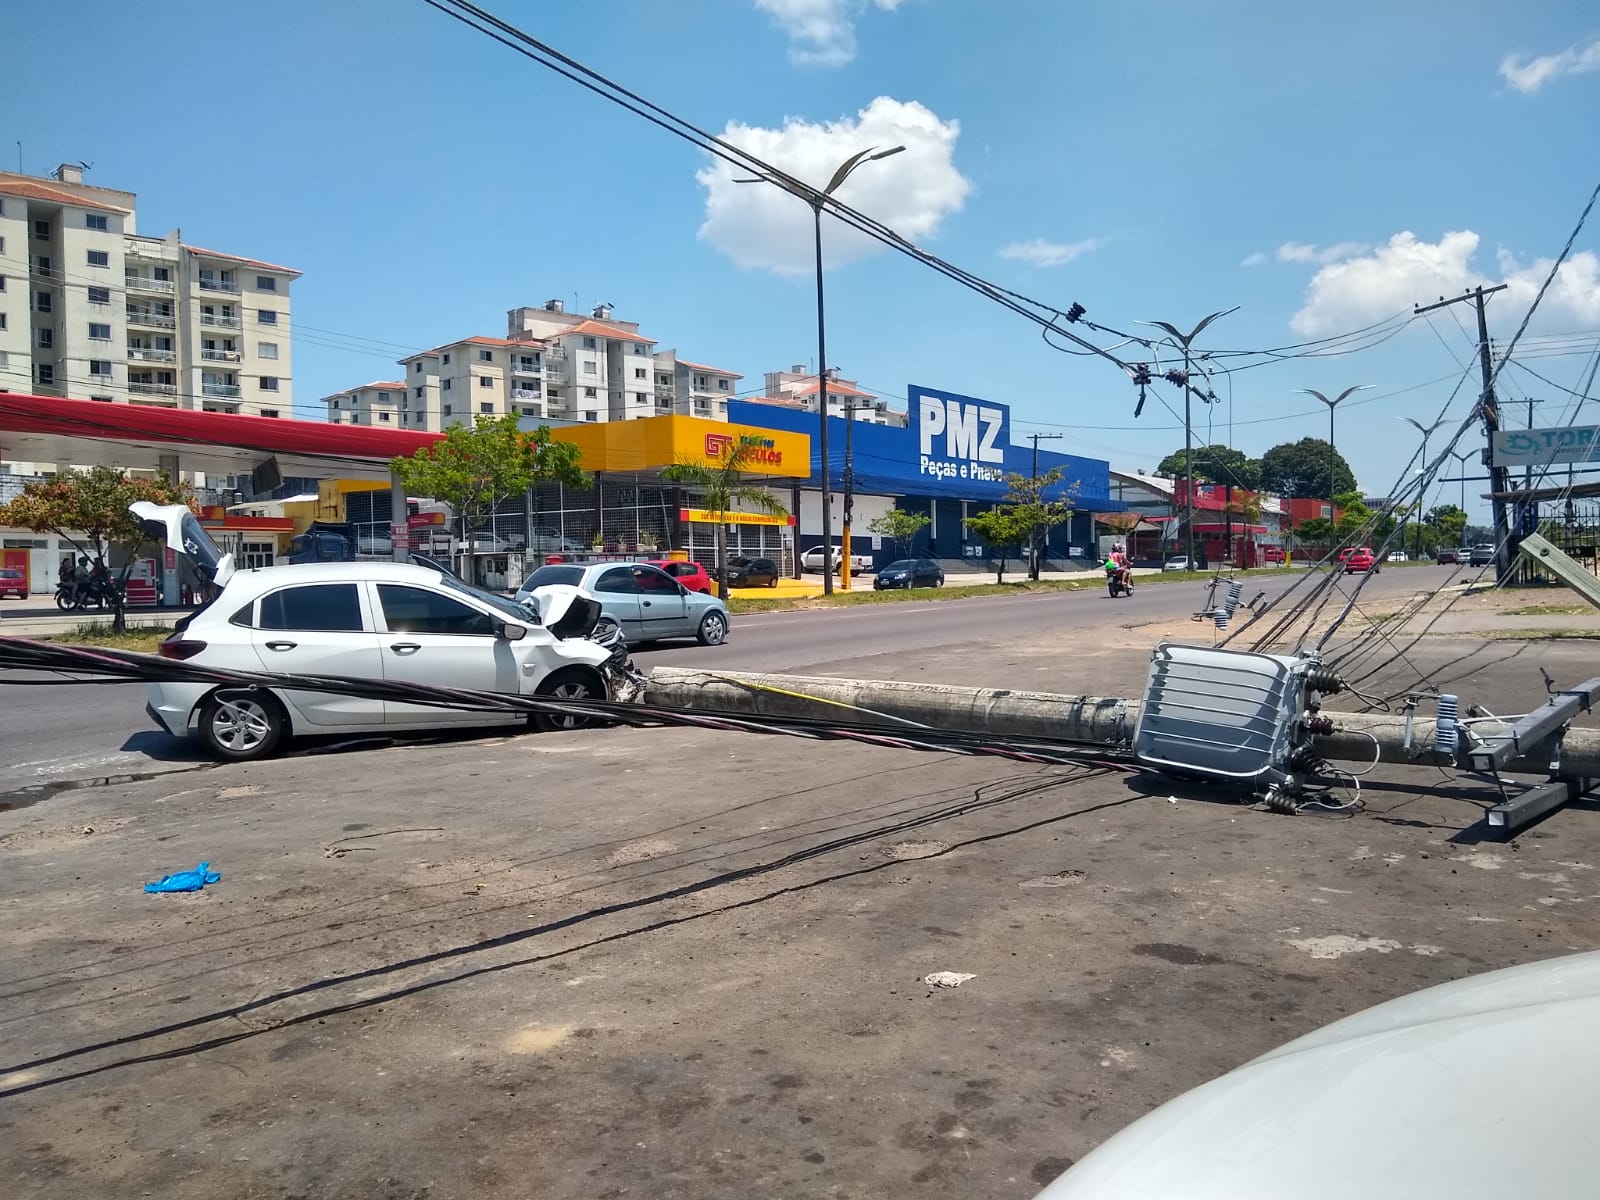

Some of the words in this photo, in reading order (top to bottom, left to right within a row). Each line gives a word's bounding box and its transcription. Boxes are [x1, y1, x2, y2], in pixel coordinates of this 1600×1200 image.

[920, 395, 1004, 464] PMZ
[705, 432, 733, 457] GT
[920, 455, 957, 481] Peças
[960, 464, 967, 478] e
